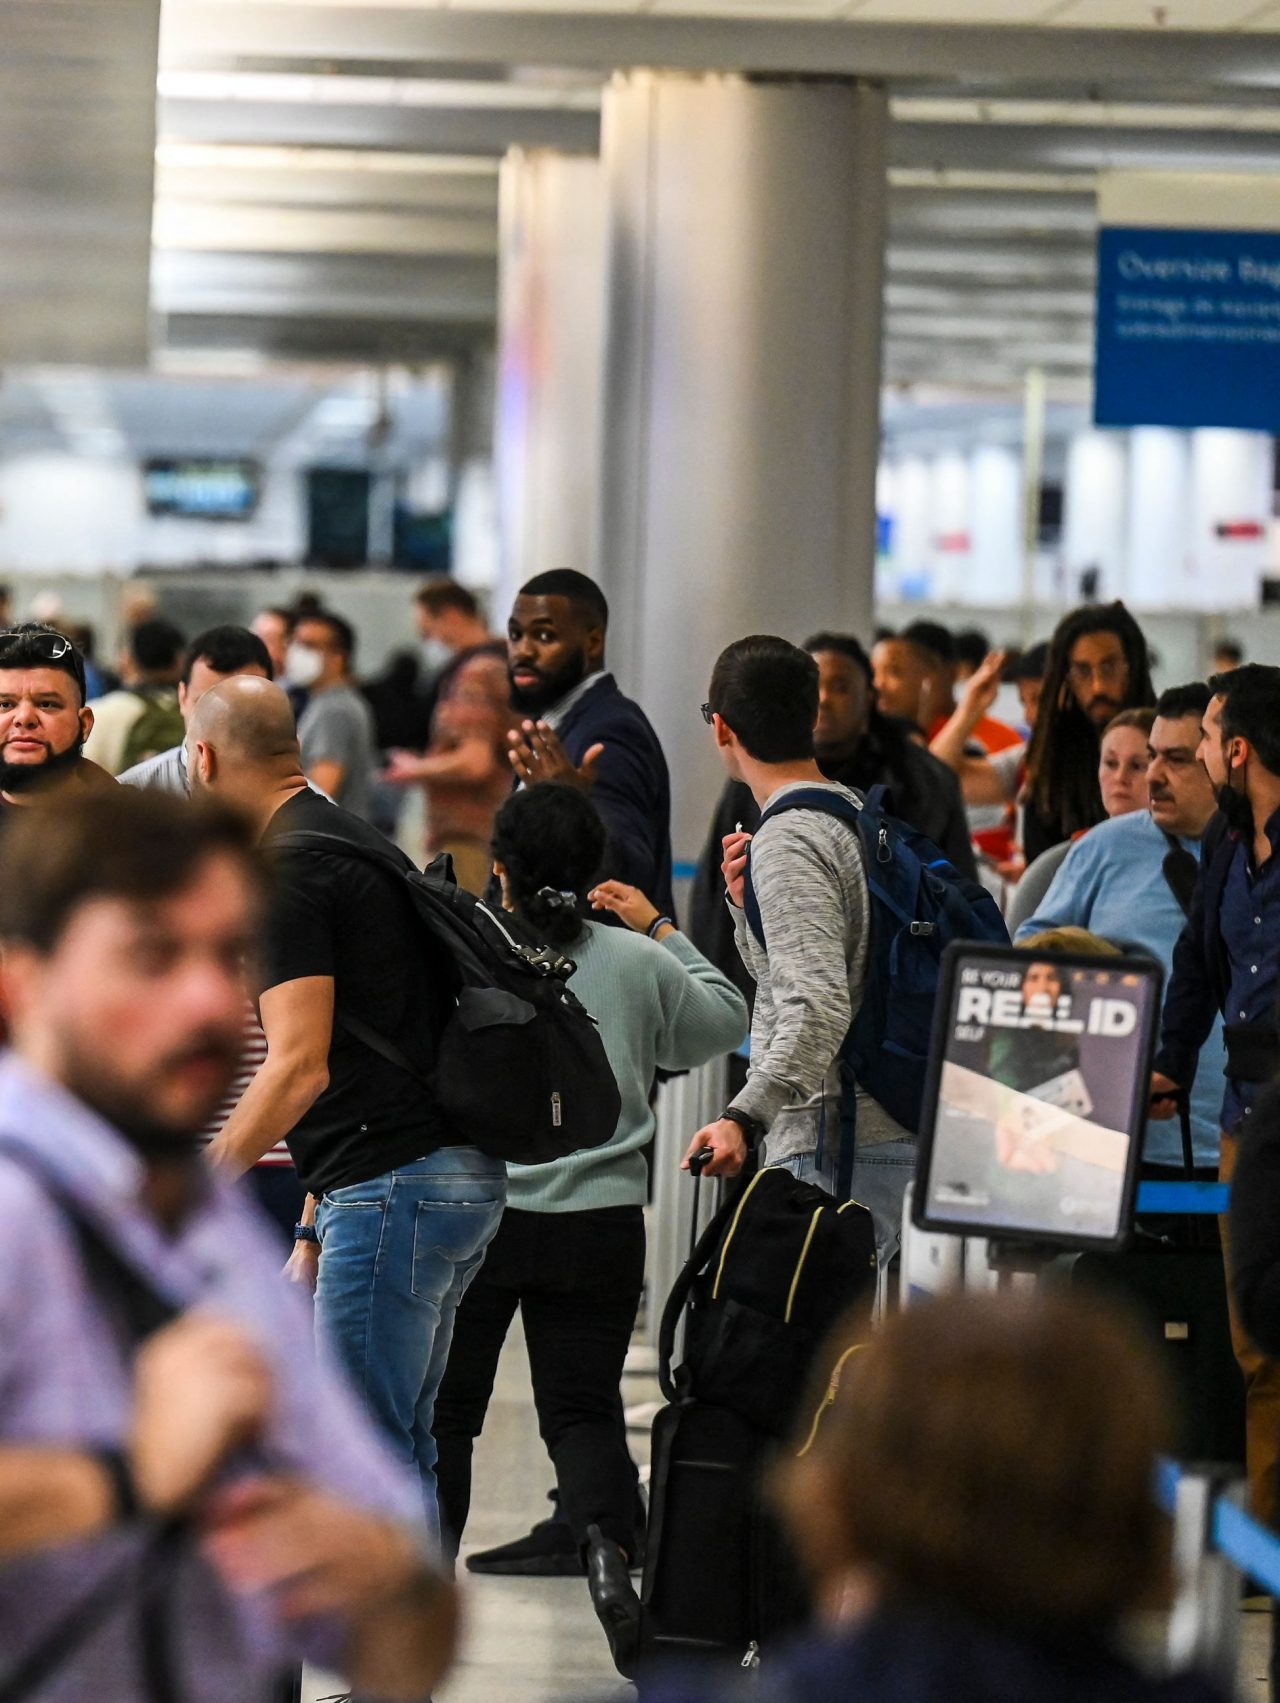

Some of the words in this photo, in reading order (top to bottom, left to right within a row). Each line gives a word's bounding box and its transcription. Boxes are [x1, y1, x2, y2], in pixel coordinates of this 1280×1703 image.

[961, 967, 979, 986] BE
[982, 970, 1021, 989] YOUR
[956, 986, 1085, 1034] REAL
[1087, 996, 1137, 1038] ID
[954, 1025, 985, 1042] SELF
